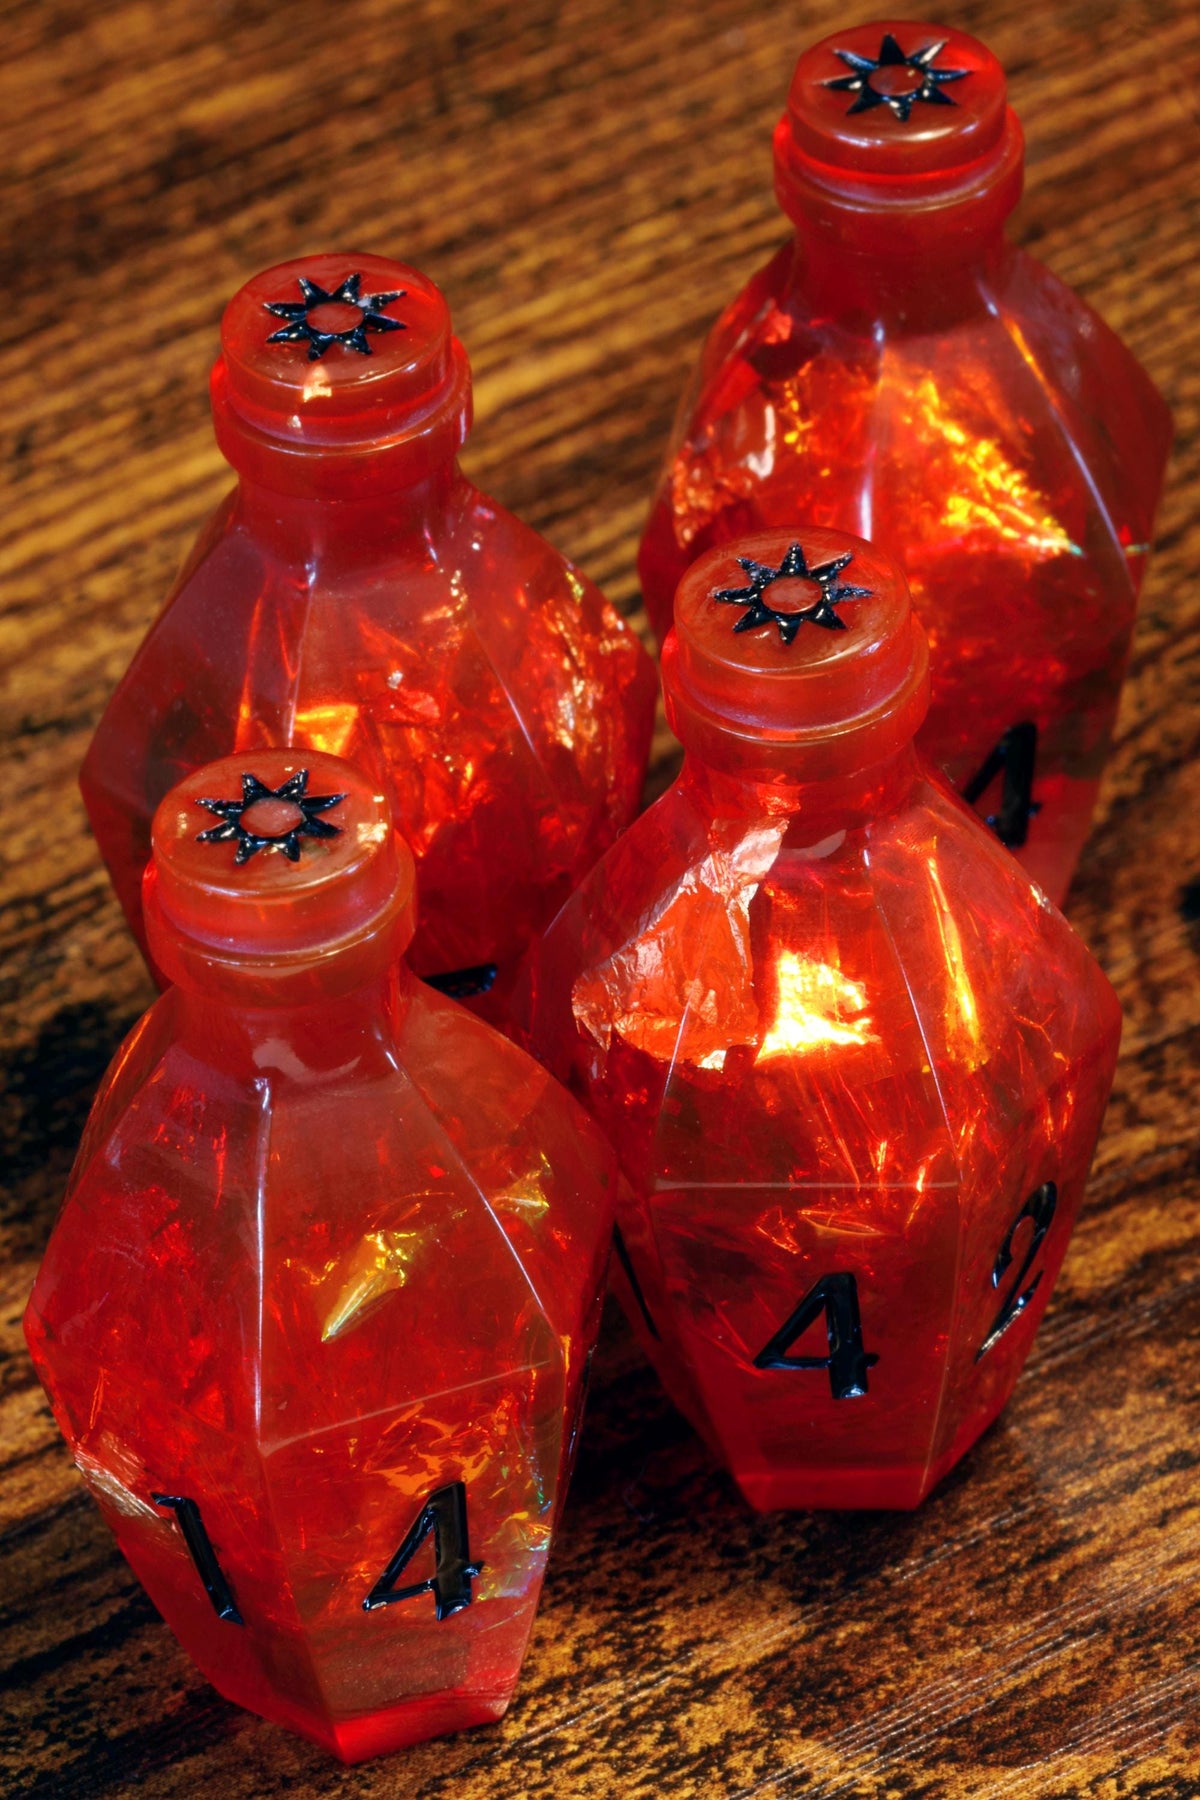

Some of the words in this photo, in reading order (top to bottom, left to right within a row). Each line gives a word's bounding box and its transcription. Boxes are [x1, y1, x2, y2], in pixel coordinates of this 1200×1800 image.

[753, 1271, 880, 1400] 4
[973, 1180, 1058, 1365] 2
[150, 1491, 245, 1625] 1
[361, 1480, 485, 1622] 4
